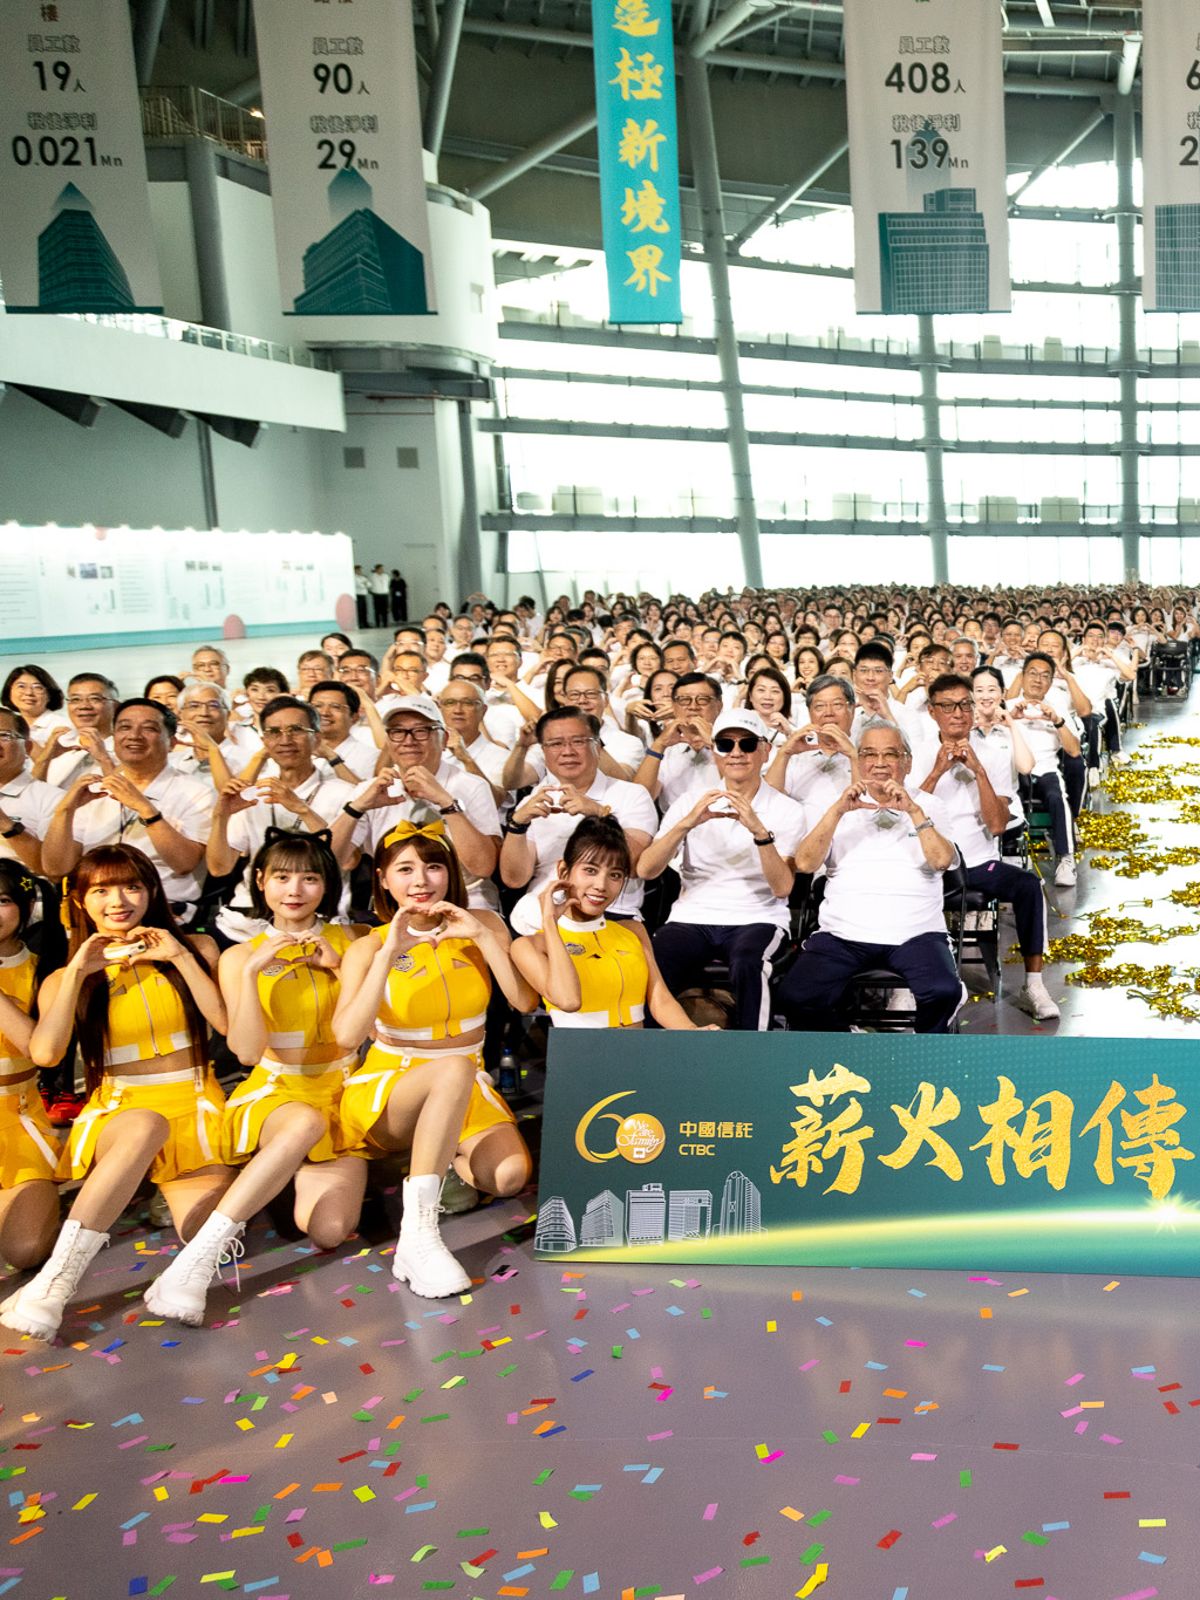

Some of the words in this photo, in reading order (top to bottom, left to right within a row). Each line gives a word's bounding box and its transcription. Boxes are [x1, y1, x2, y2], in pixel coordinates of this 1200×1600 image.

[608, 0, 672, 297] 造極新境界
[679, 1121, 753, 1138] 中國信託
[679, 1144, 715, 1156] CTBC
[769, 1063, 1195, 1200] 薪火相傳
